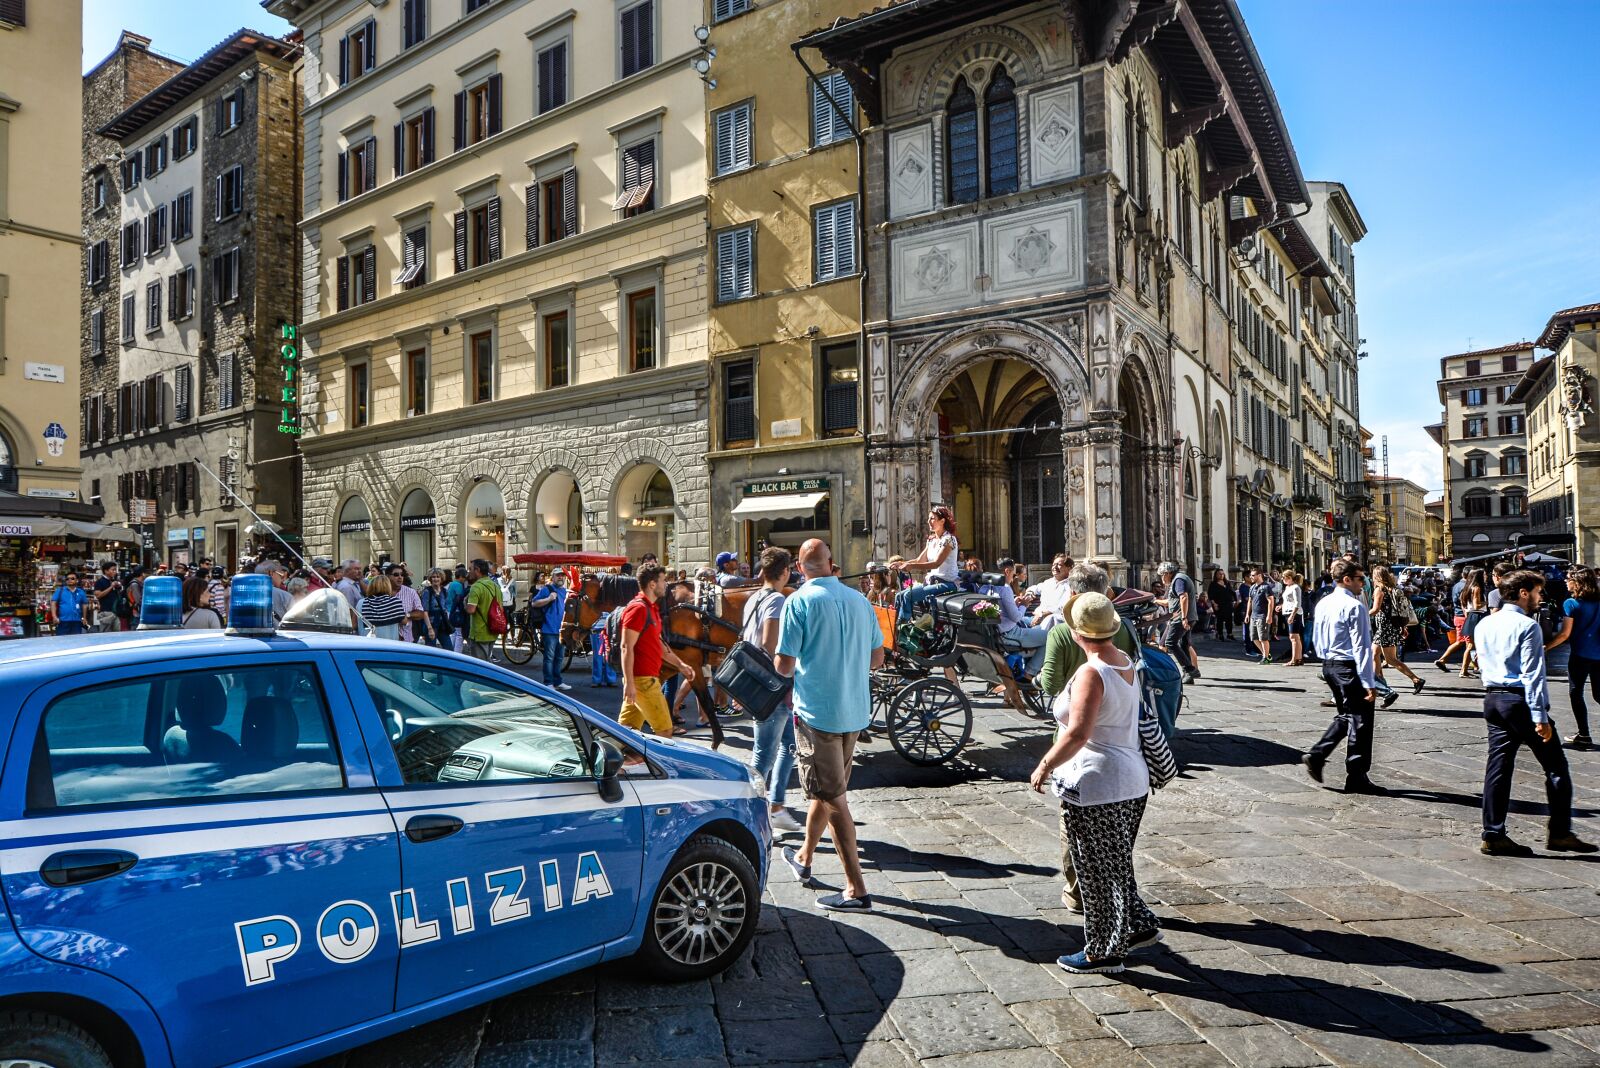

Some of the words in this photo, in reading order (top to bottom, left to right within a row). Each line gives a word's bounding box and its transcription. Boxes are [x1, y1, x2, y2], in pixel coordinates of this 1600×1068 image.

[281, 323, 297, 424] HOTEL
[751, 484, 778, 493] BLACK
[780, 481, 798, 491] BAR
[341, 522, 371, 530] intimissim
[401, 517, 436, 529] intimissim
[0, 525, 30, 535] ICOLA
[233, 850, 614, 987] POLIZIA
